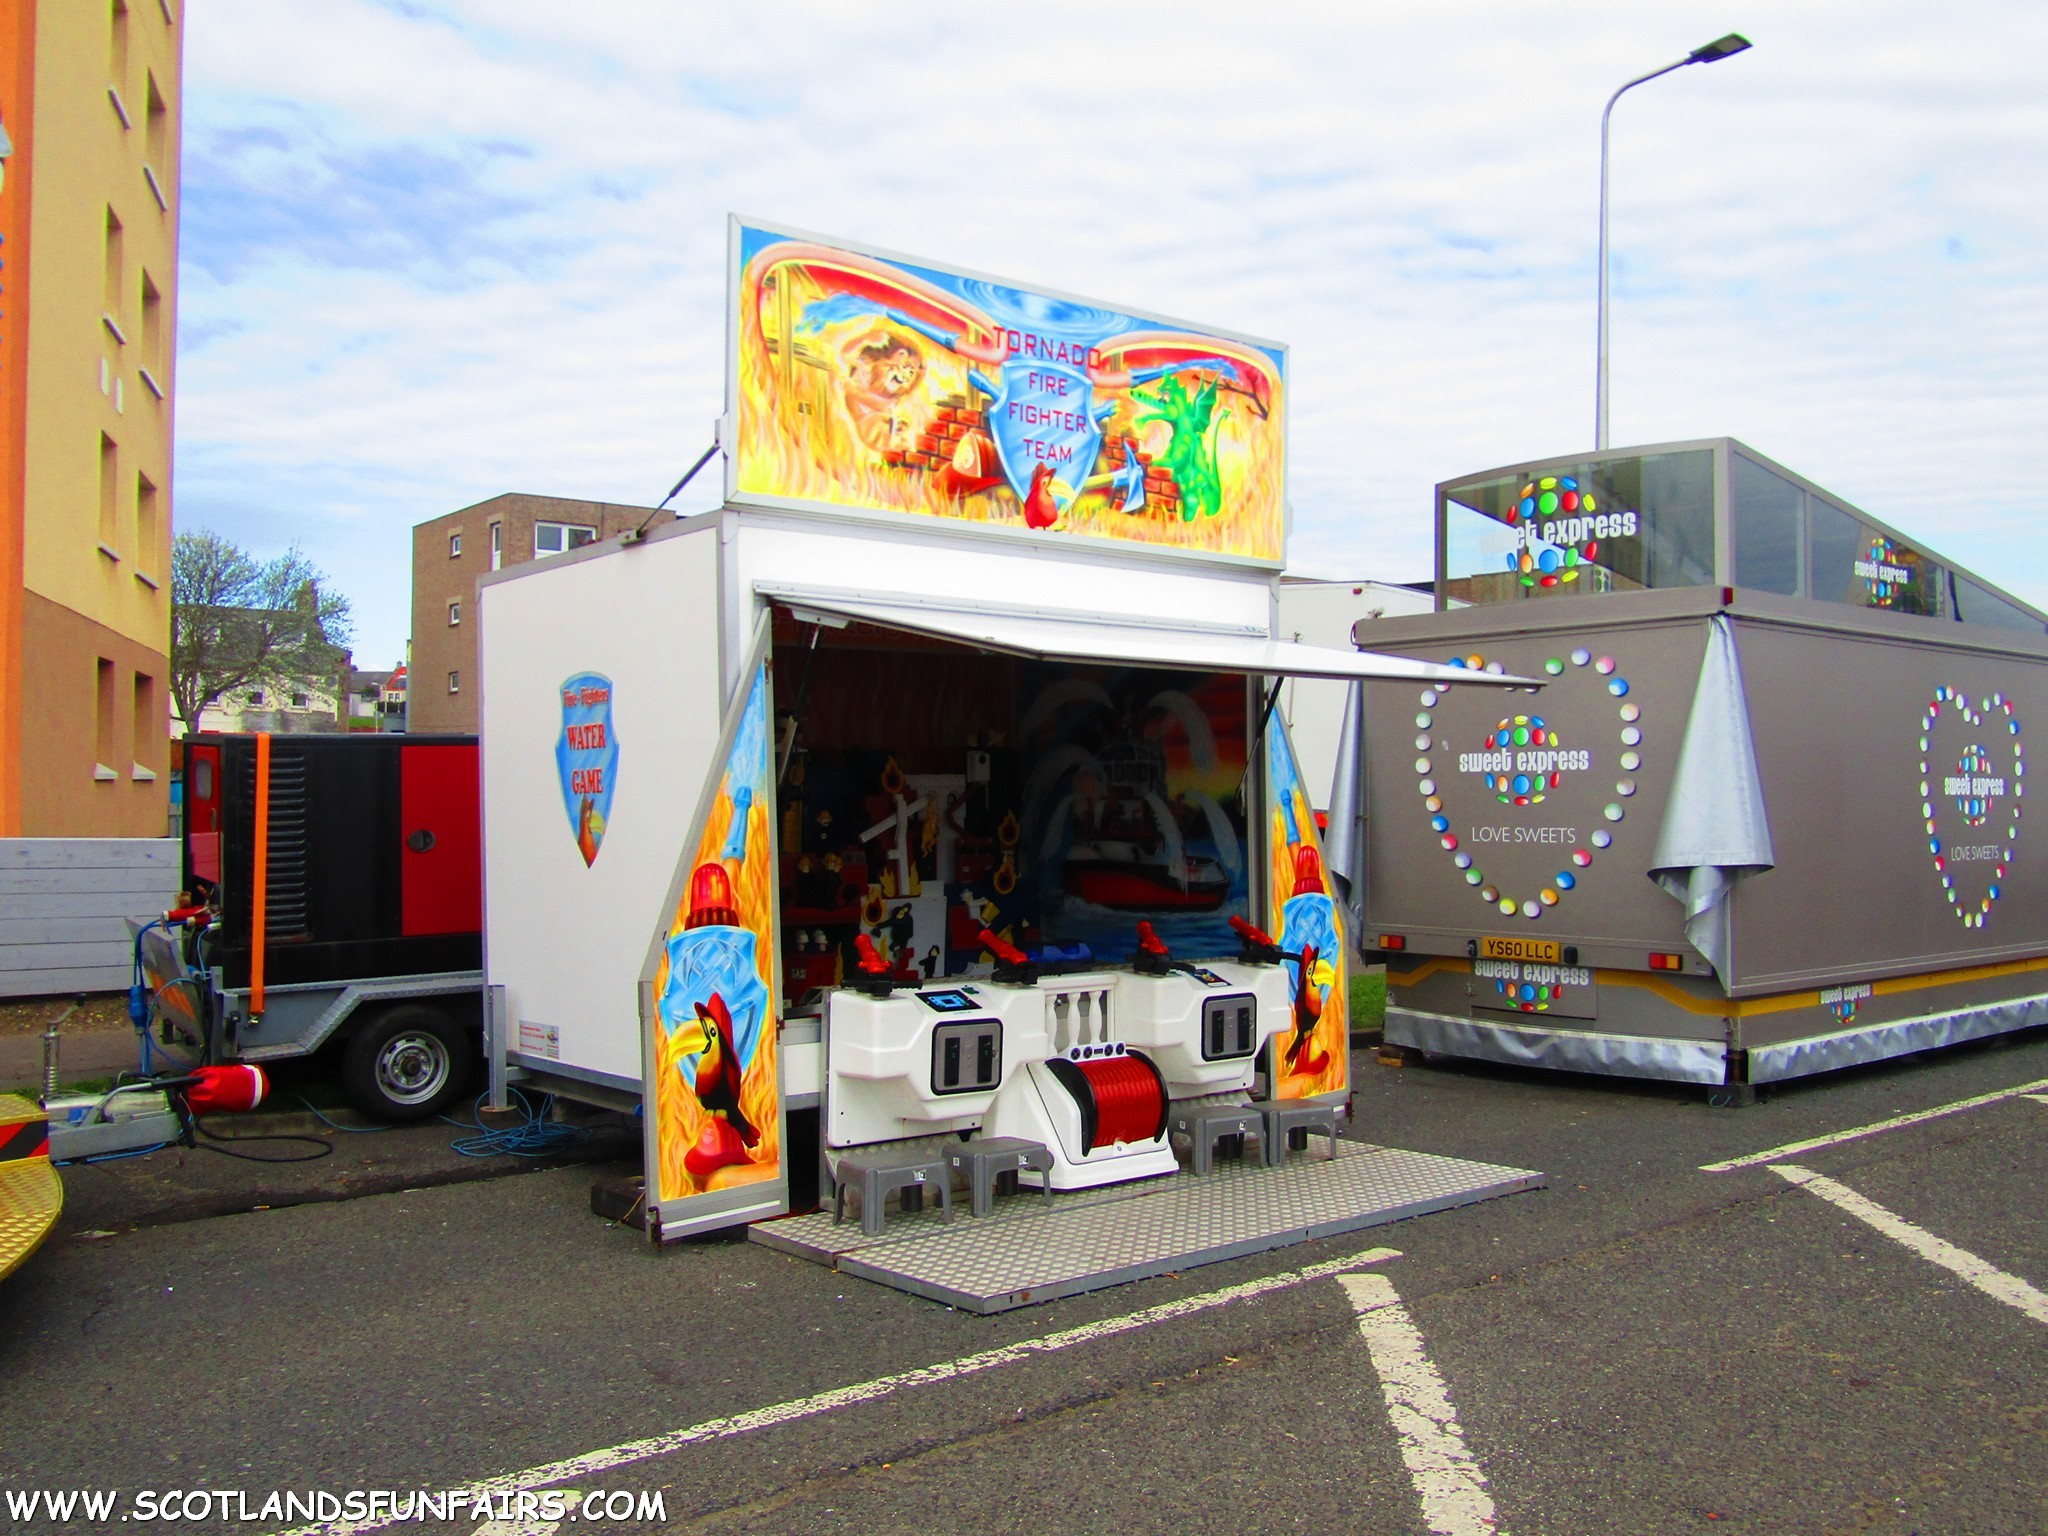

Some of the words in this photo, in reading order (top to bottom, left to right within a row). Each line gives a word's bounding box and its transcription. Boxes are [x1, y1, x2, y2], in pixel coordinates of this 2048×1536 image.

[993, 326, 1100, 369] TORNADO
[1029, 372, 1068, 396] FIRE
[1008, 402, 1086, 433] FIGHTER
[1023, 438, 1072, 463] TEAM
[1543, 511, 1637, 546] express
[567, 723, 606, 751] WATER
[1459, 748, 1512, 772] sweet
[1516, 750, 1589, 774] express
[571, 768, 603, 795] GAME
[1944, 773, 1970, 796] sweet
[1972, 777, 2004, 798] express
[1472, 827, 1510, 842] LOVE
[1514, 827, 1576, 844] SWEETS
[1951, 846, 1971, 861] LOVE
[1972, 845, 1999, 860] SWEETS
[1488, 940, 1522, 957] YS60
[1525, 943, 1553, 959] LLC
[1475, 960, 1519, 980] sweet
[1523, 964, 1589, 986] express
